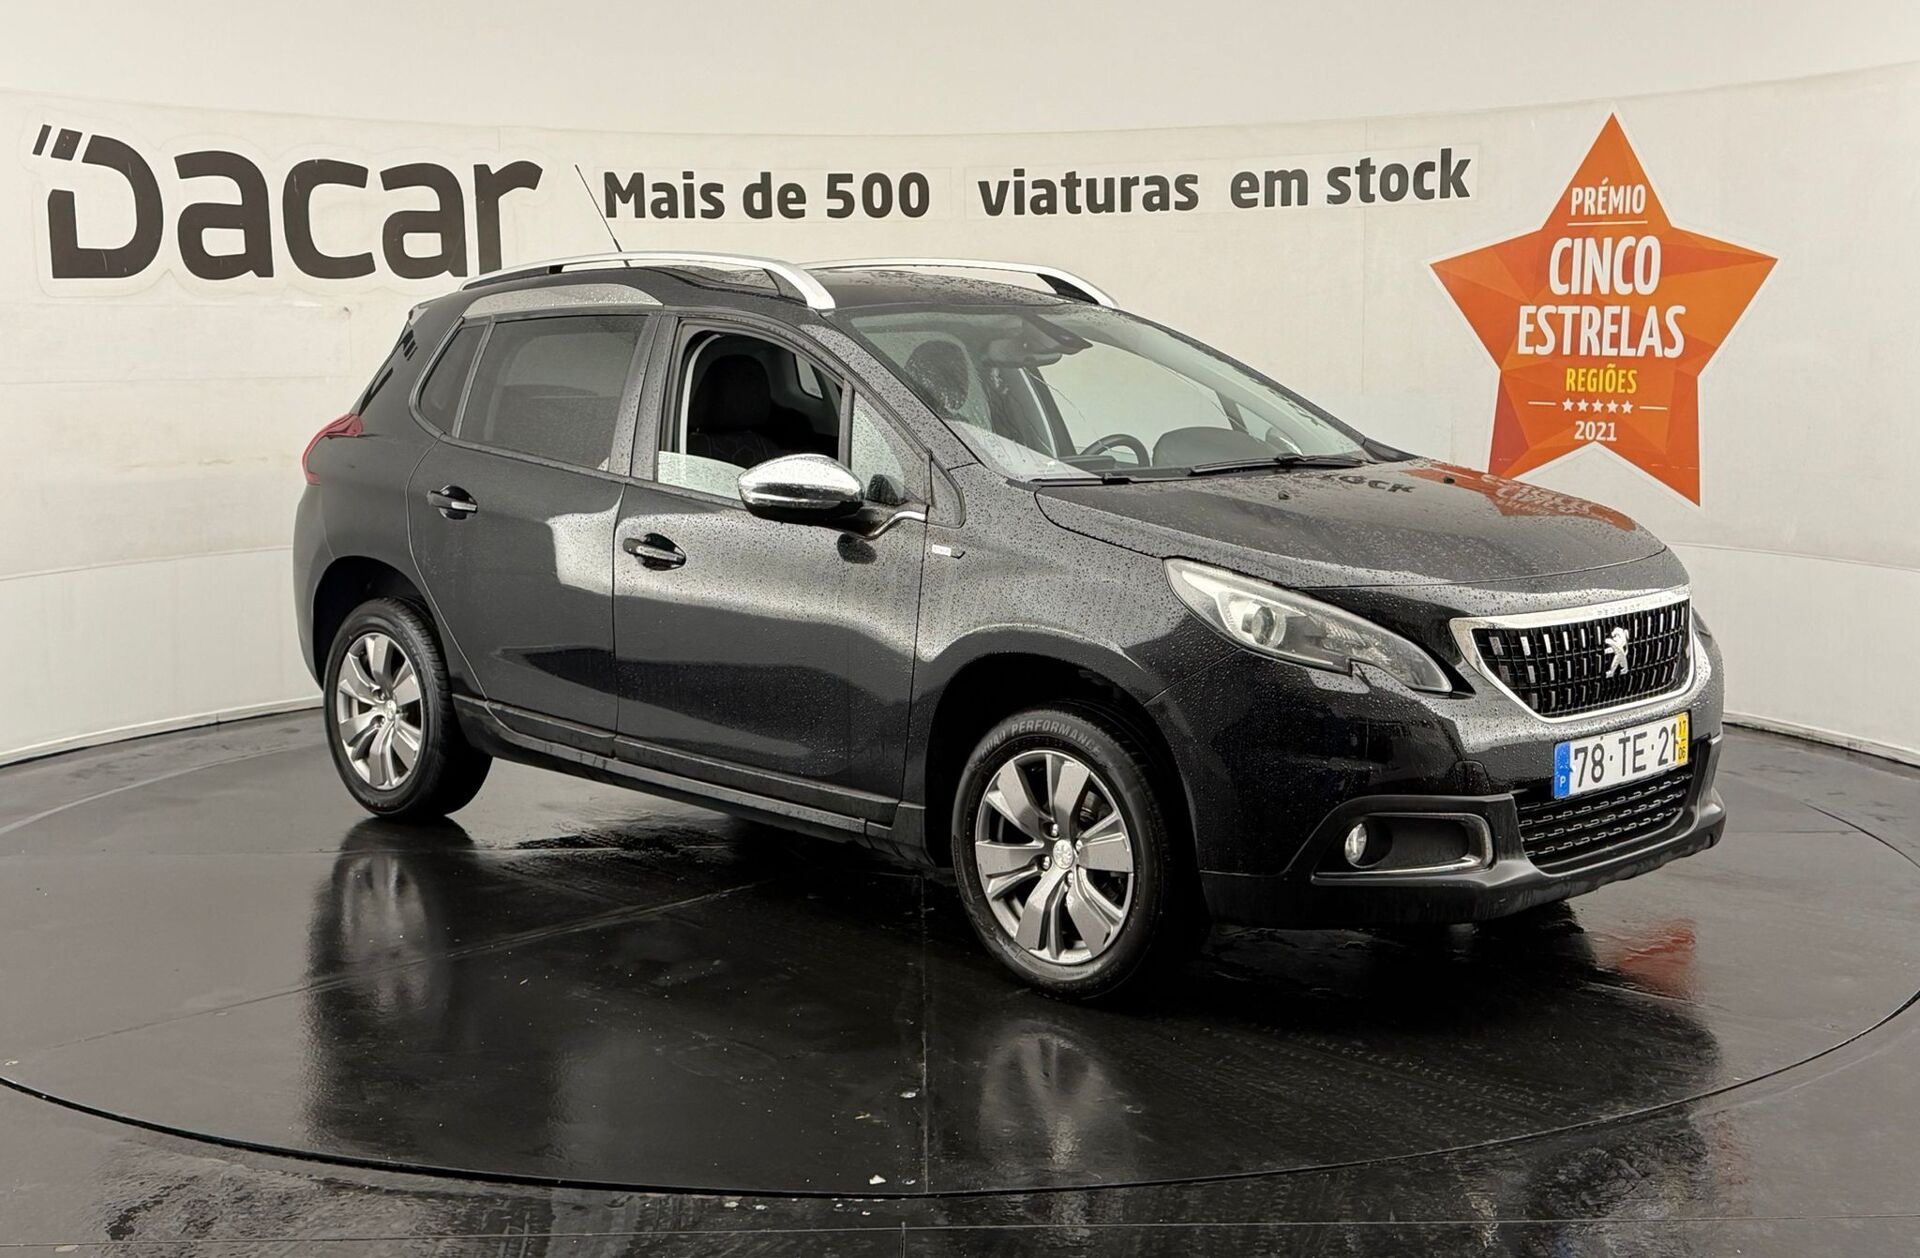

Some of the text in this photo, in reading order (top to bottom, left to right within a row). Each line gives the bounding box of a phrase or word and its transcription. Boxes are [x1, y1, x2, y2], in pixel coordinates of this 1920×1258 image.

[33, 124, 543, 280] Dacar
[605, 148, 1471, 220] Mais de 500 viaturas em stock
[1570, 177, 1647, 216] PRÉMIO
[1549, 235, 1662, 296] CINCO
[1517, 304, 1686, 359] ESTRELAS
[1565, 363, 1638, 394] REGIÕES
[1574, 420, 1617, 442] 2021
[1011, 719, 1102, 753] PERFORMANCE
[1559, 776, 1567, 788] P
